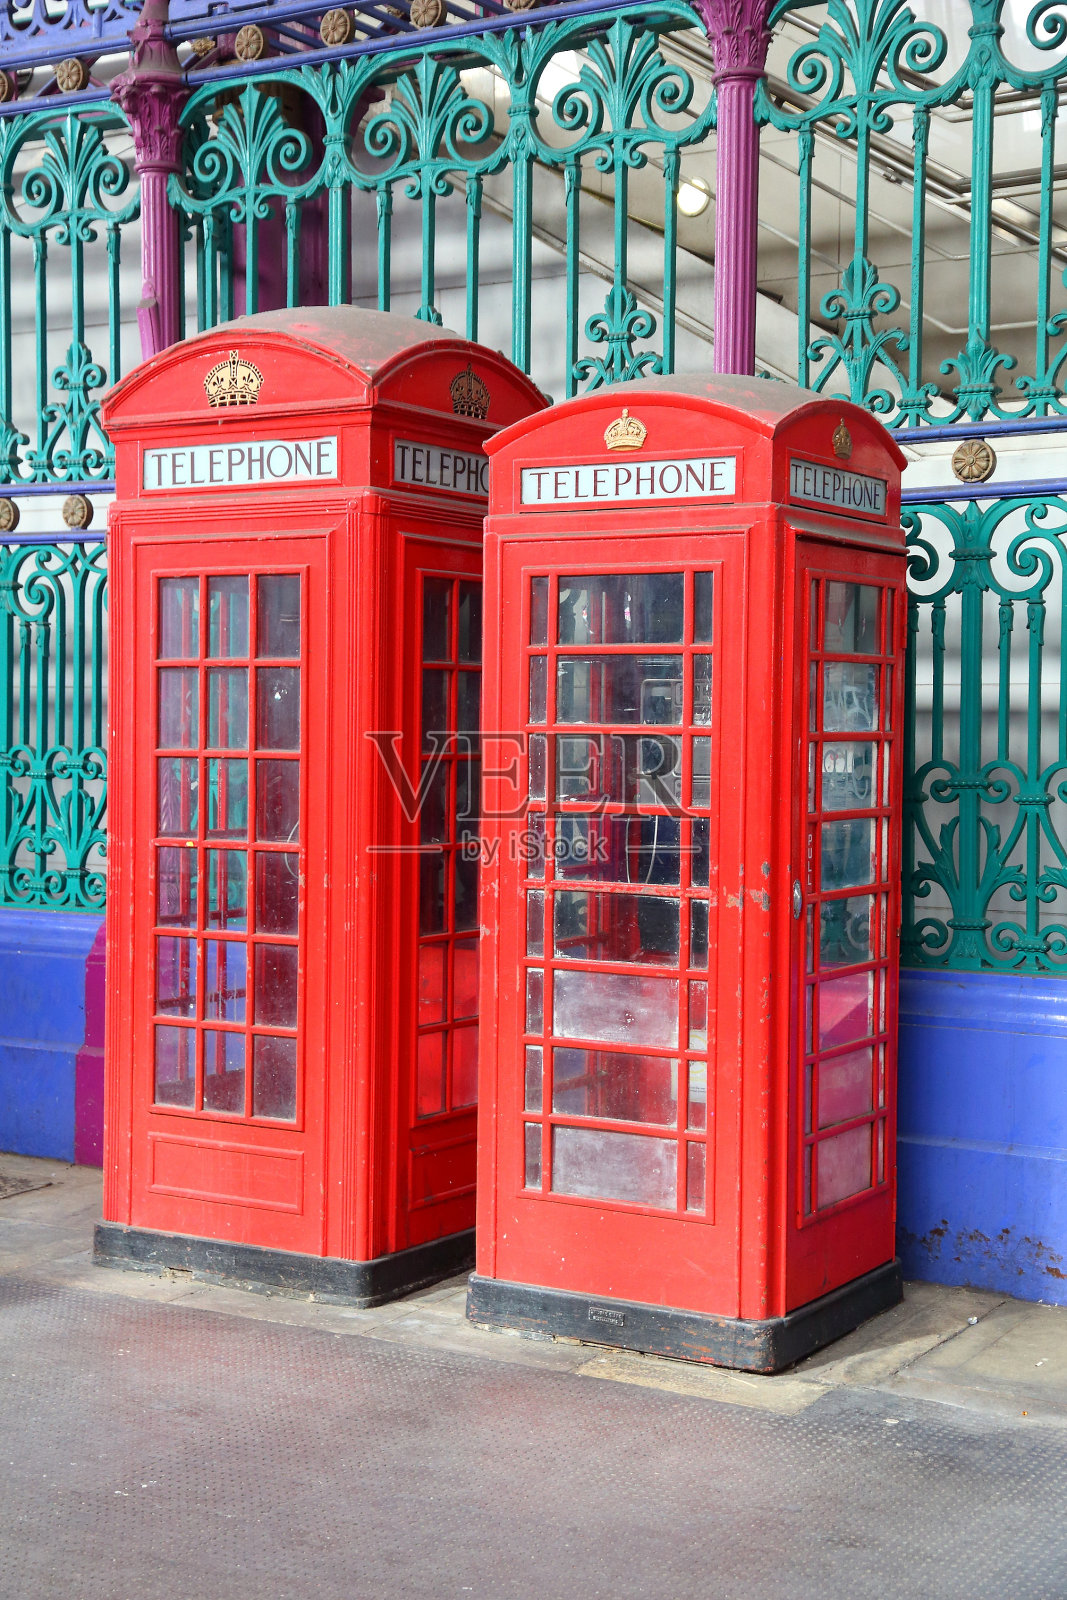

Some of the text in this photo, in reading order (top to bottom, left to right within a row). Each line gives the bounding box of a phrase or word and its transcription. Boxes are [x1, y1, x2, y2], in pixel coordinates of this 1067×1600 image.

[152, 441, 332, 486] TELEPHONE
[529, 461, 726, 500] TELEPHONE
[791, 463, 881, 510] TELEPHONE
